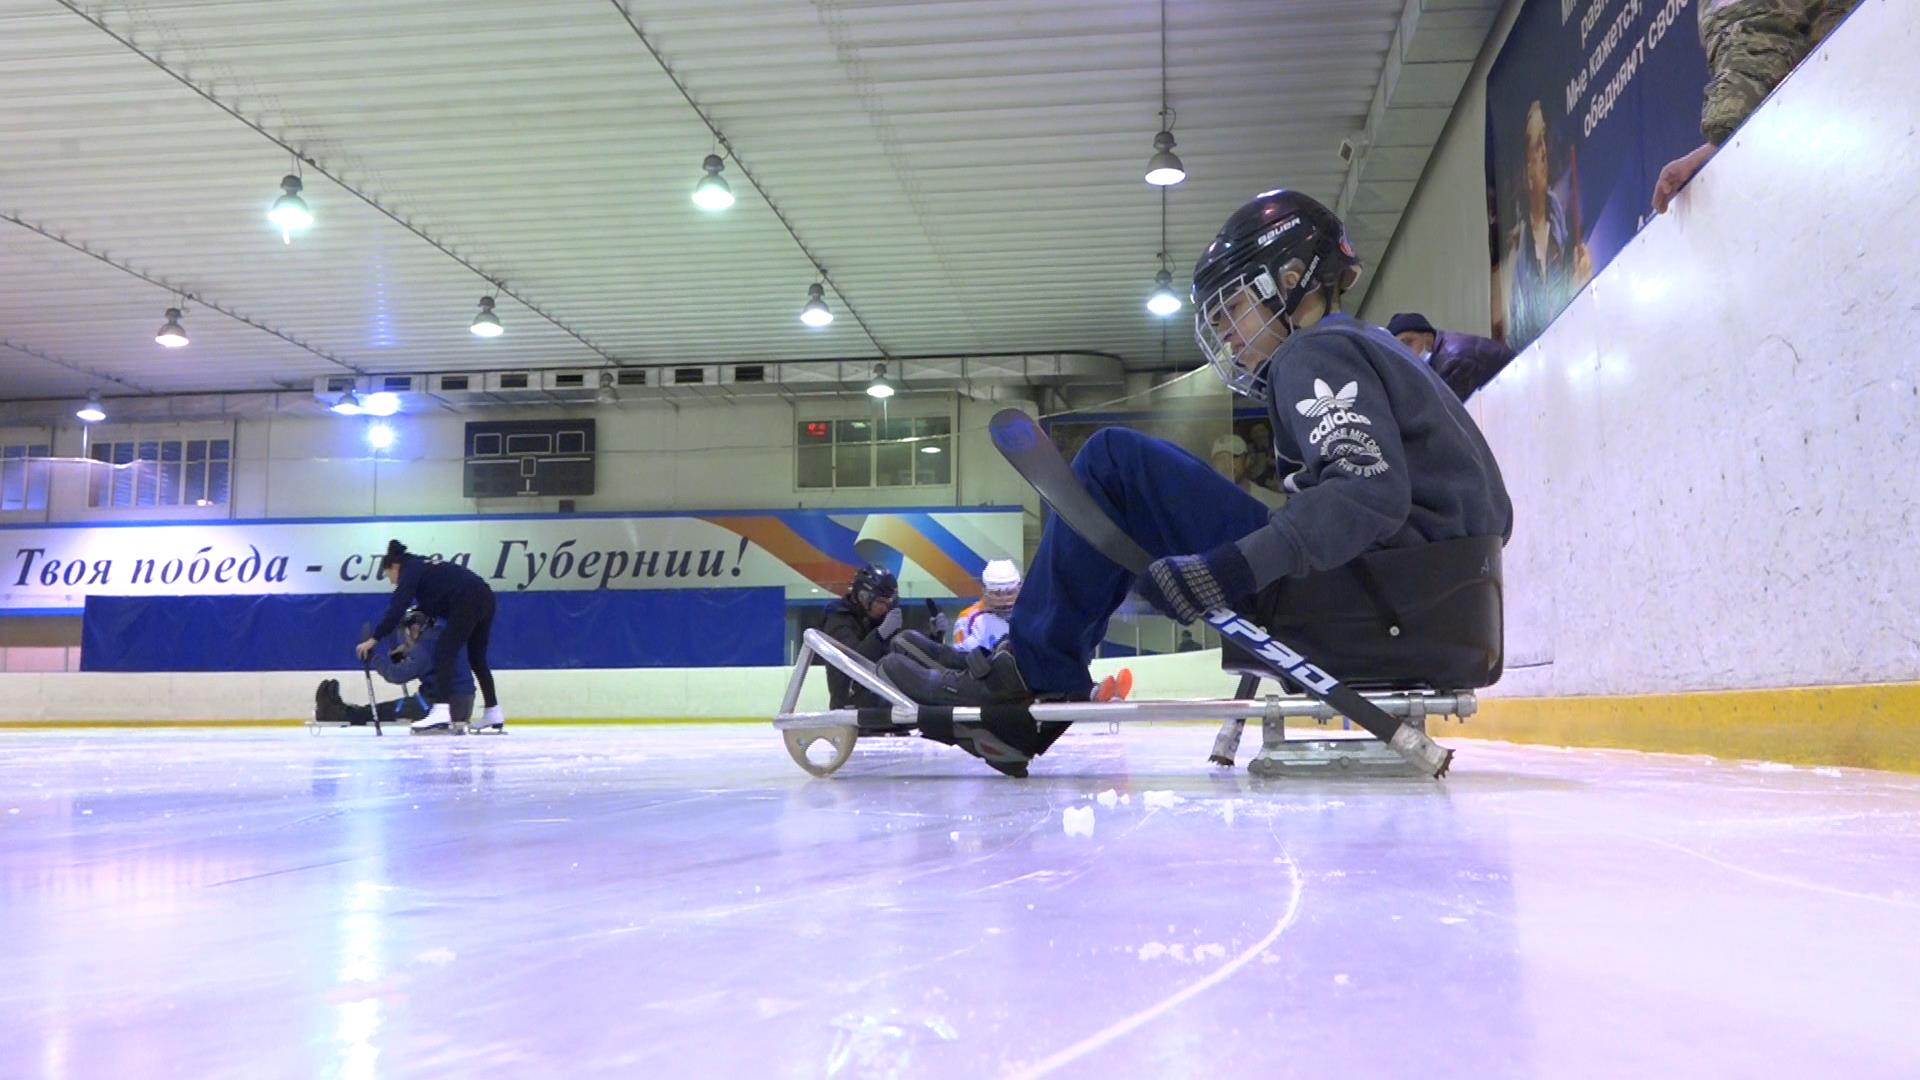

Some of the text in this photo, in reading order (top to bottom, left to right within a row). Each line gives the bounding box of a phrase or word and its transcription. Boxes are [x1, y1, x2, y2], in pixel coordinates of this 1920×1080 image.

[1566, 0, 1642, 115] Мне кажется,
[1584, 36, 1646, 138] обедняют
[1309, 406, 1372, 445] adidas
[13, 548, 112, 586] Твоя
[131, 544, 290, 584] победа
[490, 536, 749, 591] Губернии!
